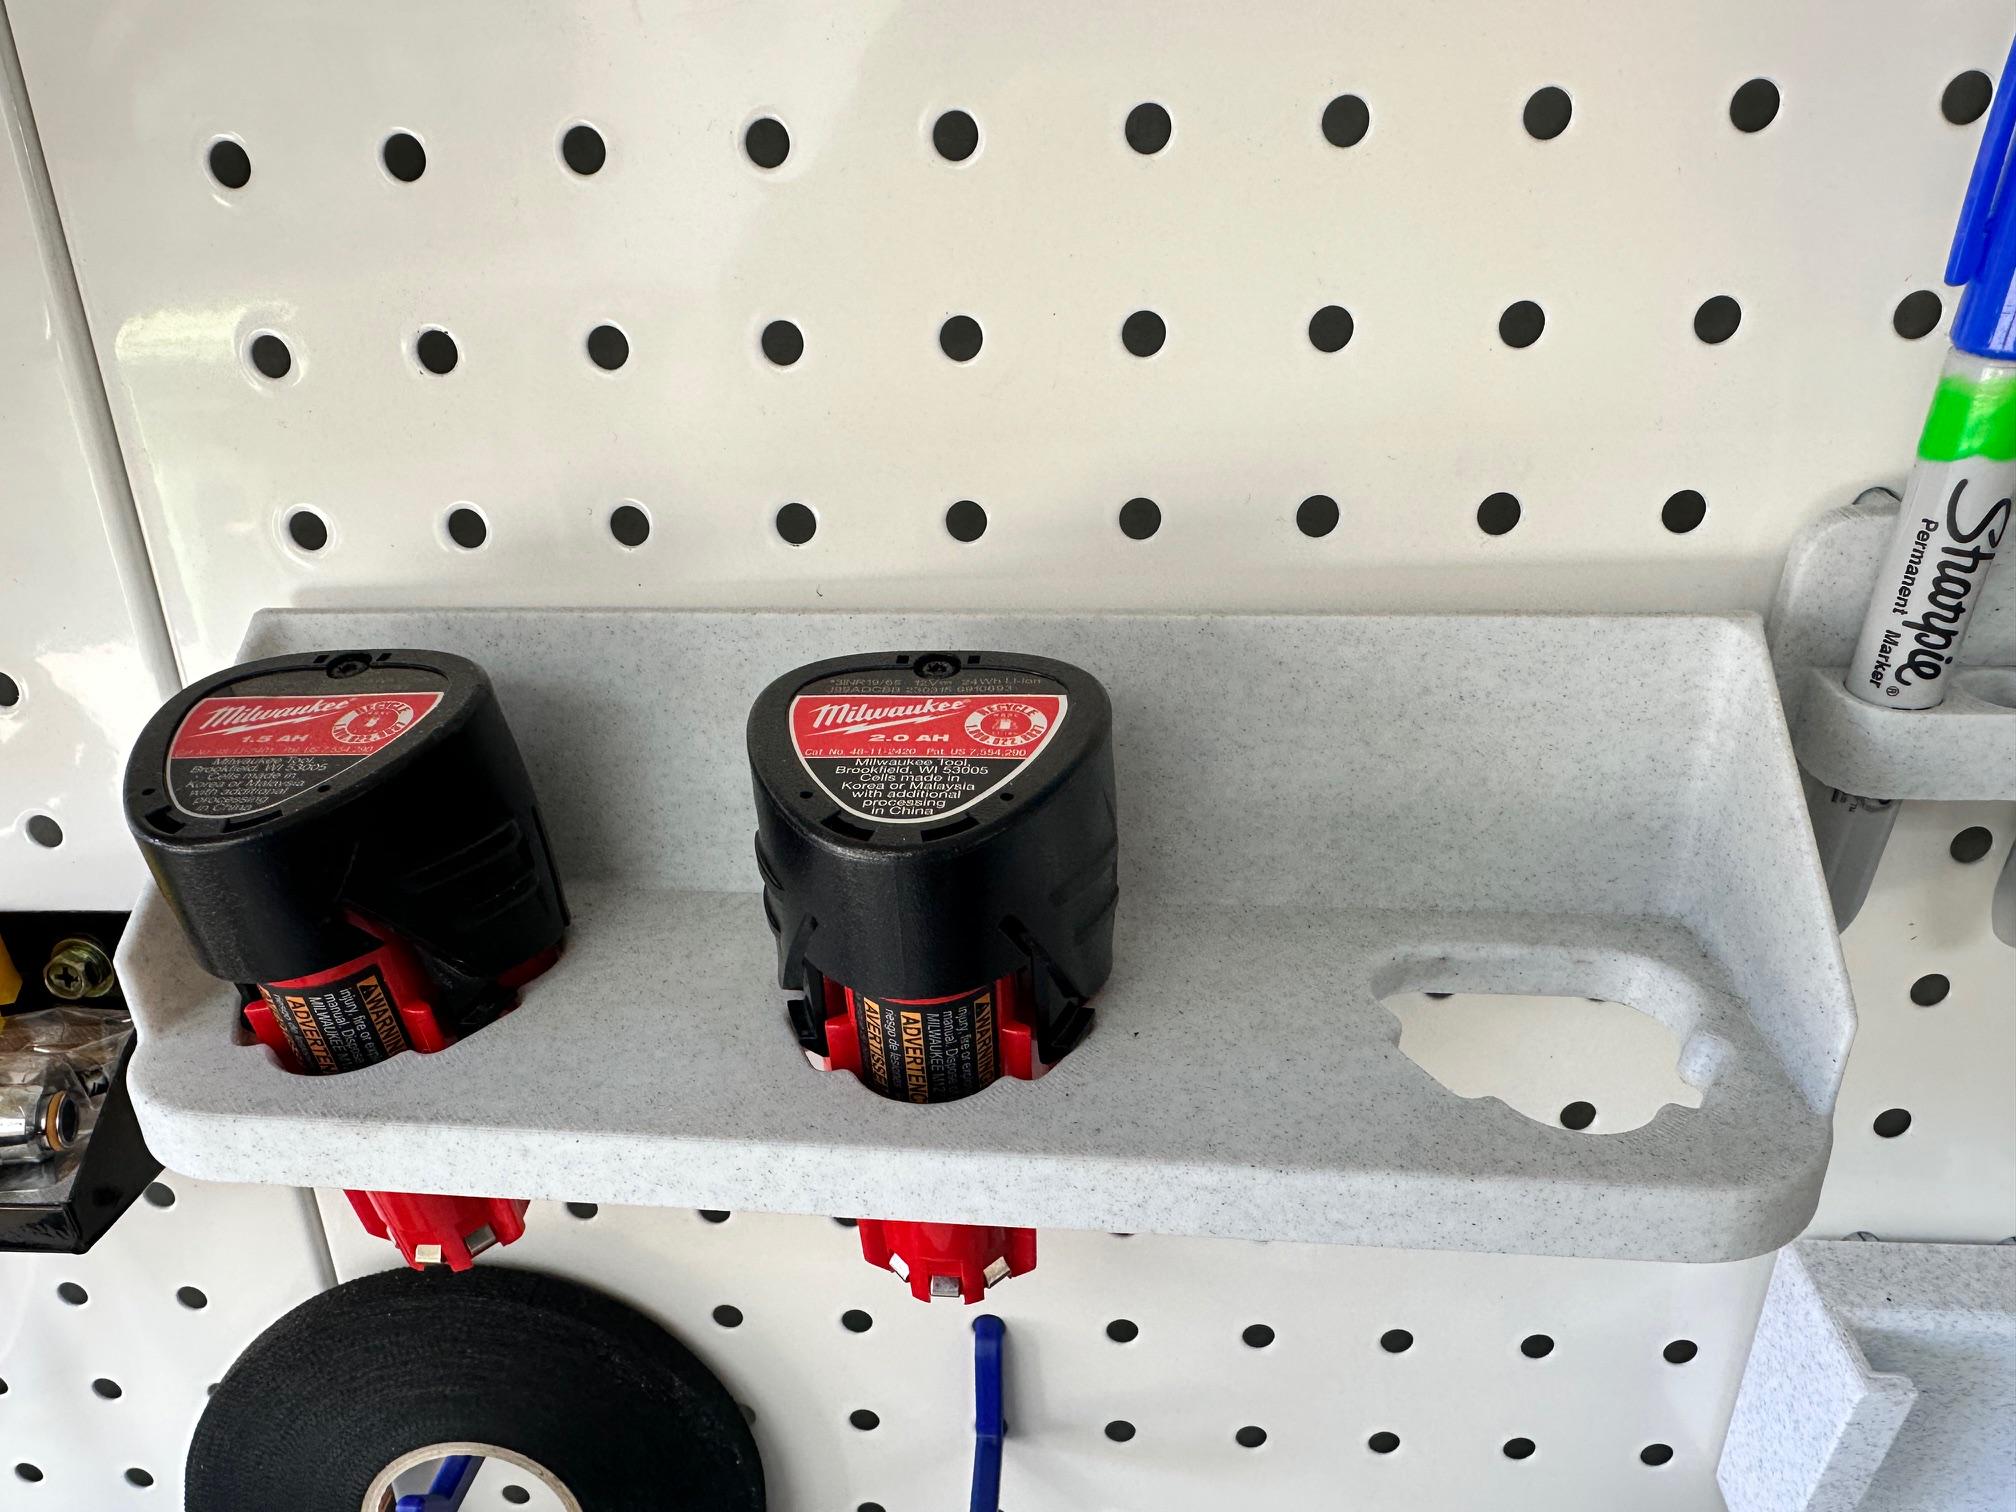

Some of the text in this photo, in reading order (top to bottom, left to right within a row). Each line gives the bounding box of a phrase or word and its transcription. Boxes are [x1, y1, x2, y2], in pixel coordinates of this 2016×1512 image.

[1896, 478, 2011, 686] Sharpie
[1869, 518, 1938, 689] Permanent Marker
[200, 699, 350, 730] Milwaukee
[809, 699, 964, 729] Milwaukee
[241, 735, 307, 744] 1.5 AH
[868, 733, 949, 743] 2.0 AH
[951, 748, 966, 756] US
[285, 763, 328, 771] 53005
[855, 758, 971, 767] Milwaukee Tool,
[835, 766, 989, 774] Brookfield, WI 53005
[860, 774, 960, 782] Cells made in
[190, 788, 218, 796] with
[841, 781, 885, 790] Korea
[909, 781, 975, 791] Malaysia
[193, 796, 269, 805] processing
[852, 790, 961, 799] with additional
[212, 804, 253, 812] China
[862, 799, 946, 808] processing
[871, 806, 933, 815] in China
[324, 993, 351, 1028] manual.
[340, 987, 359, 1016] injury,
[353, 1014, 367, 1030] fire
[360, 1031, 372, 1041] or
[308, 996, 344, 1052] MILWAUKEE
[366, 989, 407, 1056] WARNIN
[884, 1008, 897, 1038] riesgo
[943, 1010, 956, 1047] manual.
[288, 999, 338, 1074] ADVERTEN
[926, 1013, 944, 1071] MILWAUKEE
[865, 1003, 889, 1087] AVERTISSE
[889, 1038, 902, 1051] de
[902, 1014, 928, 1103] ADVERTENC
